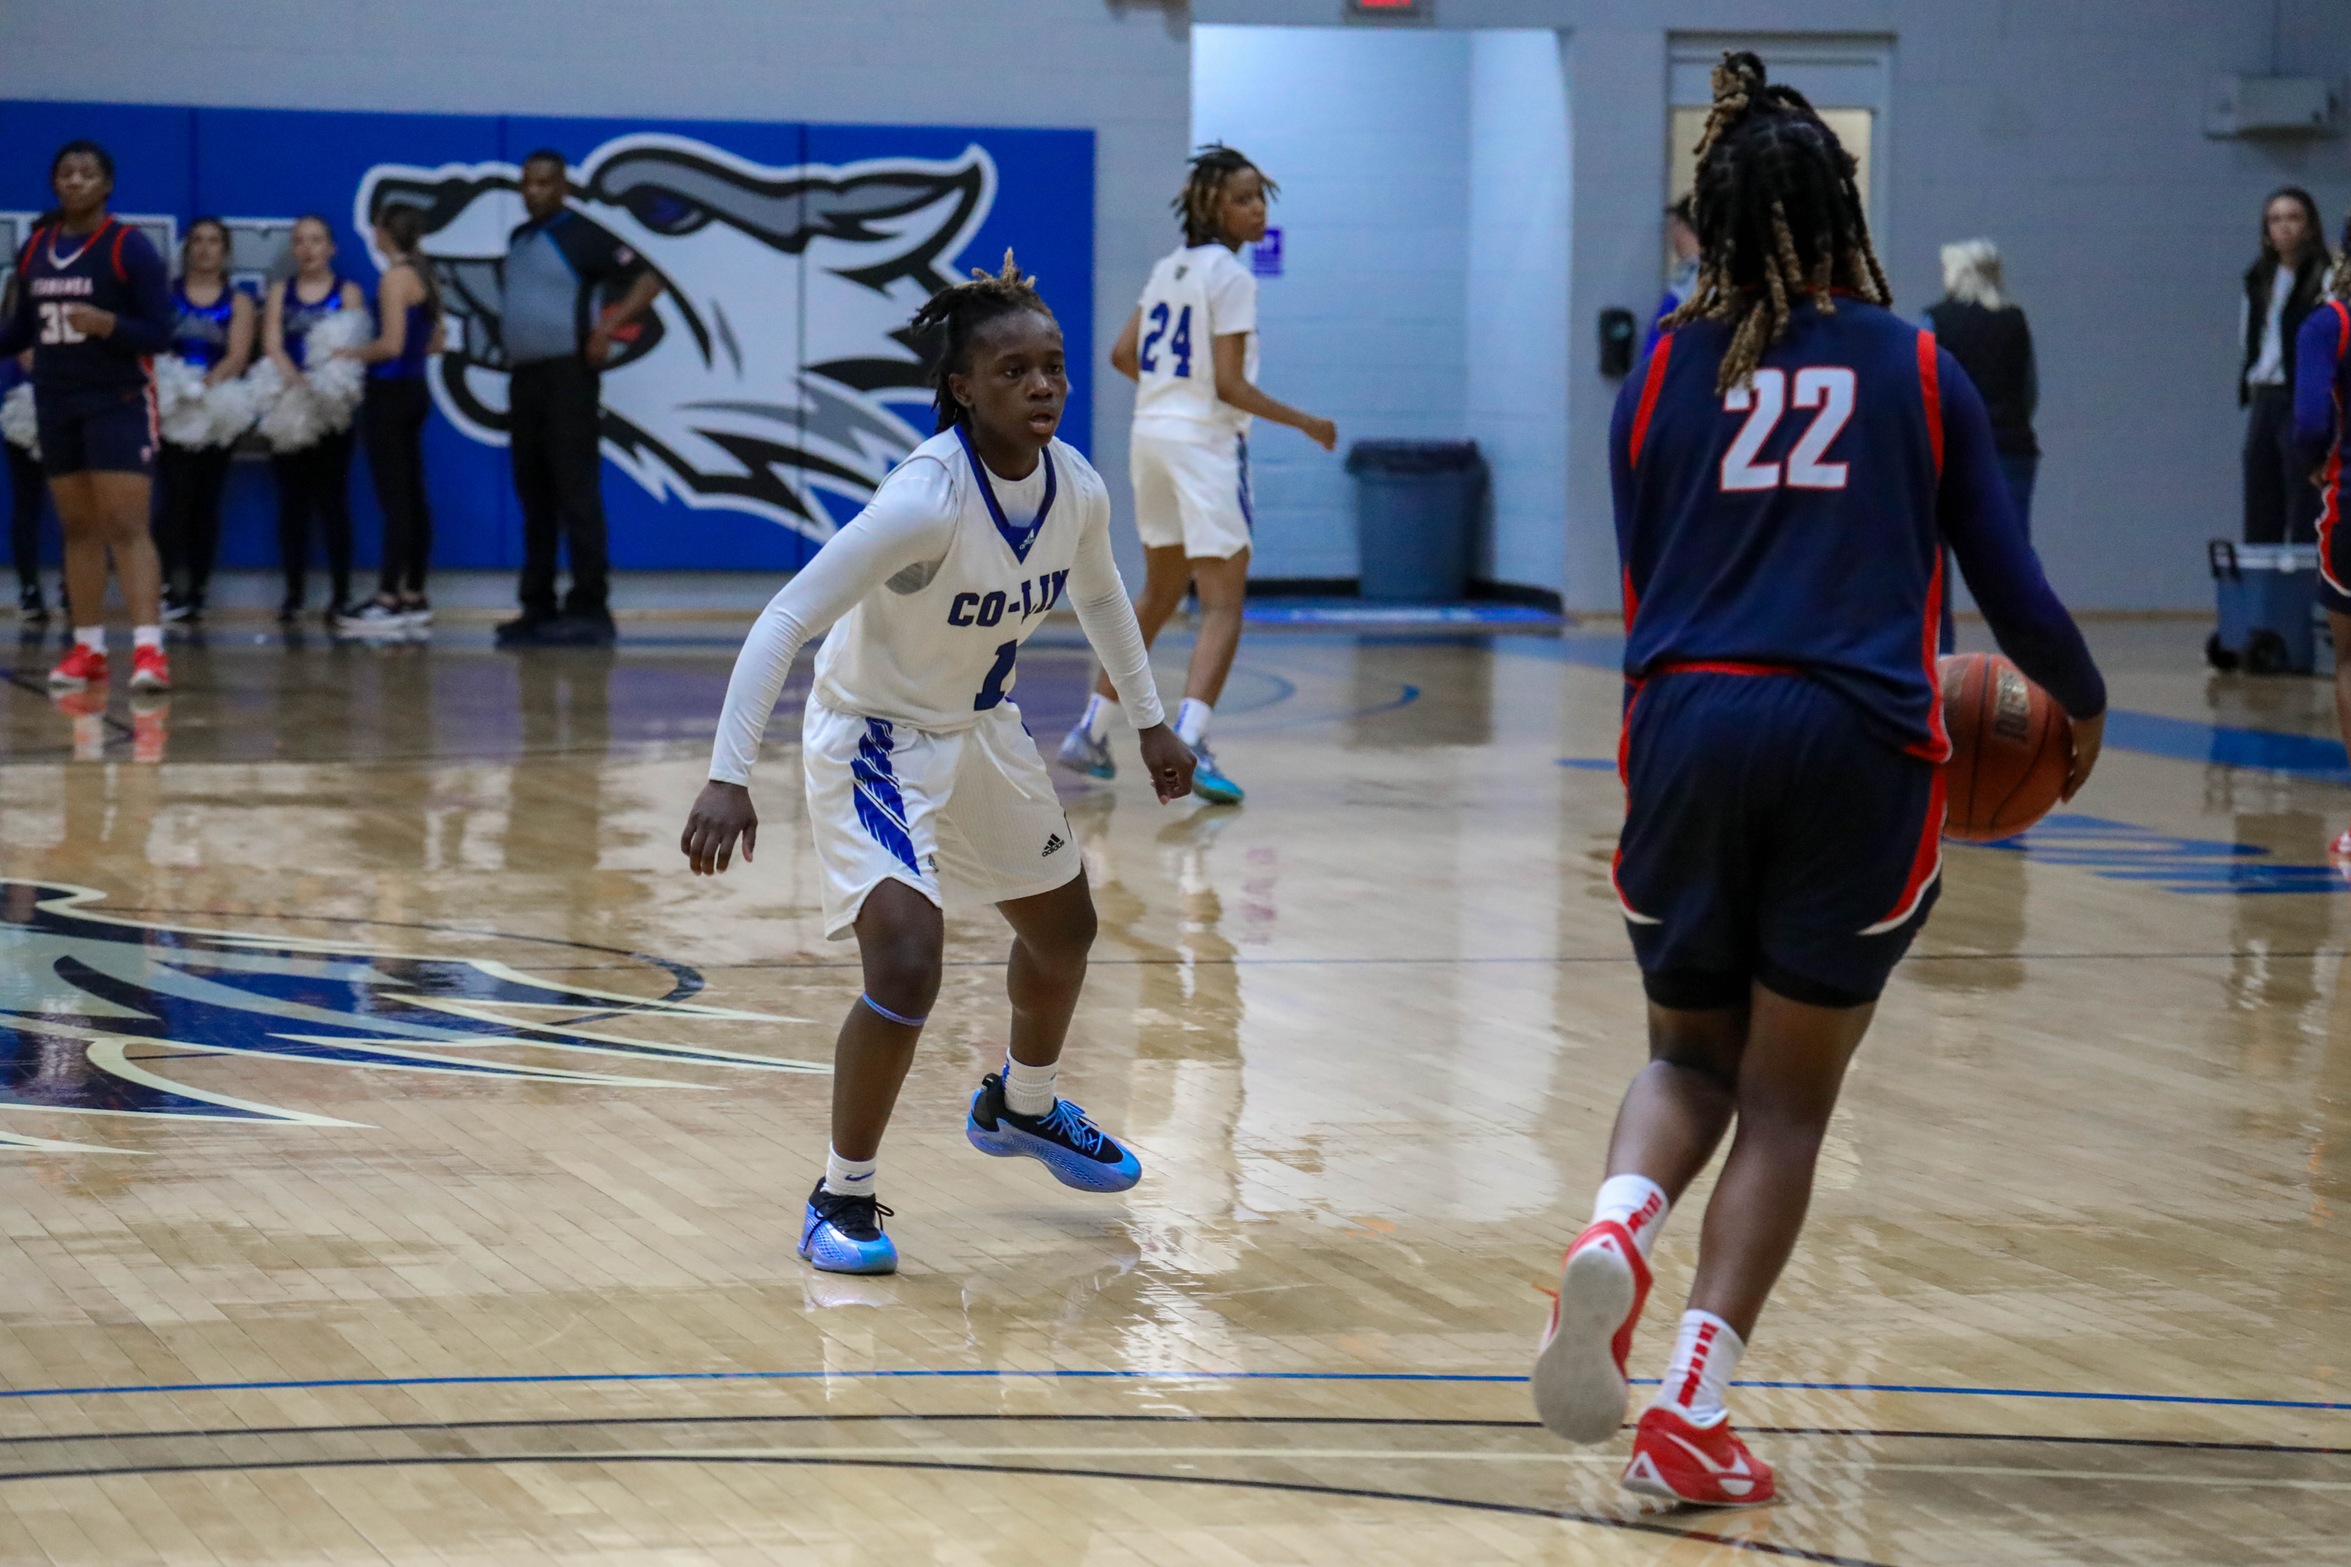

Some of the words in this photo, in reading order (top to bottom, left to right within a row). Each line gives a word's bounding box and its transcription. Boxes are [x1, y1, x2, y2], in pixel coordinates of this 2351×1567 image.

[1141, 302, 1191, 377] 24
[1720, 366, 1857, 491] 22
[974, 639, 1018, 711] 1
